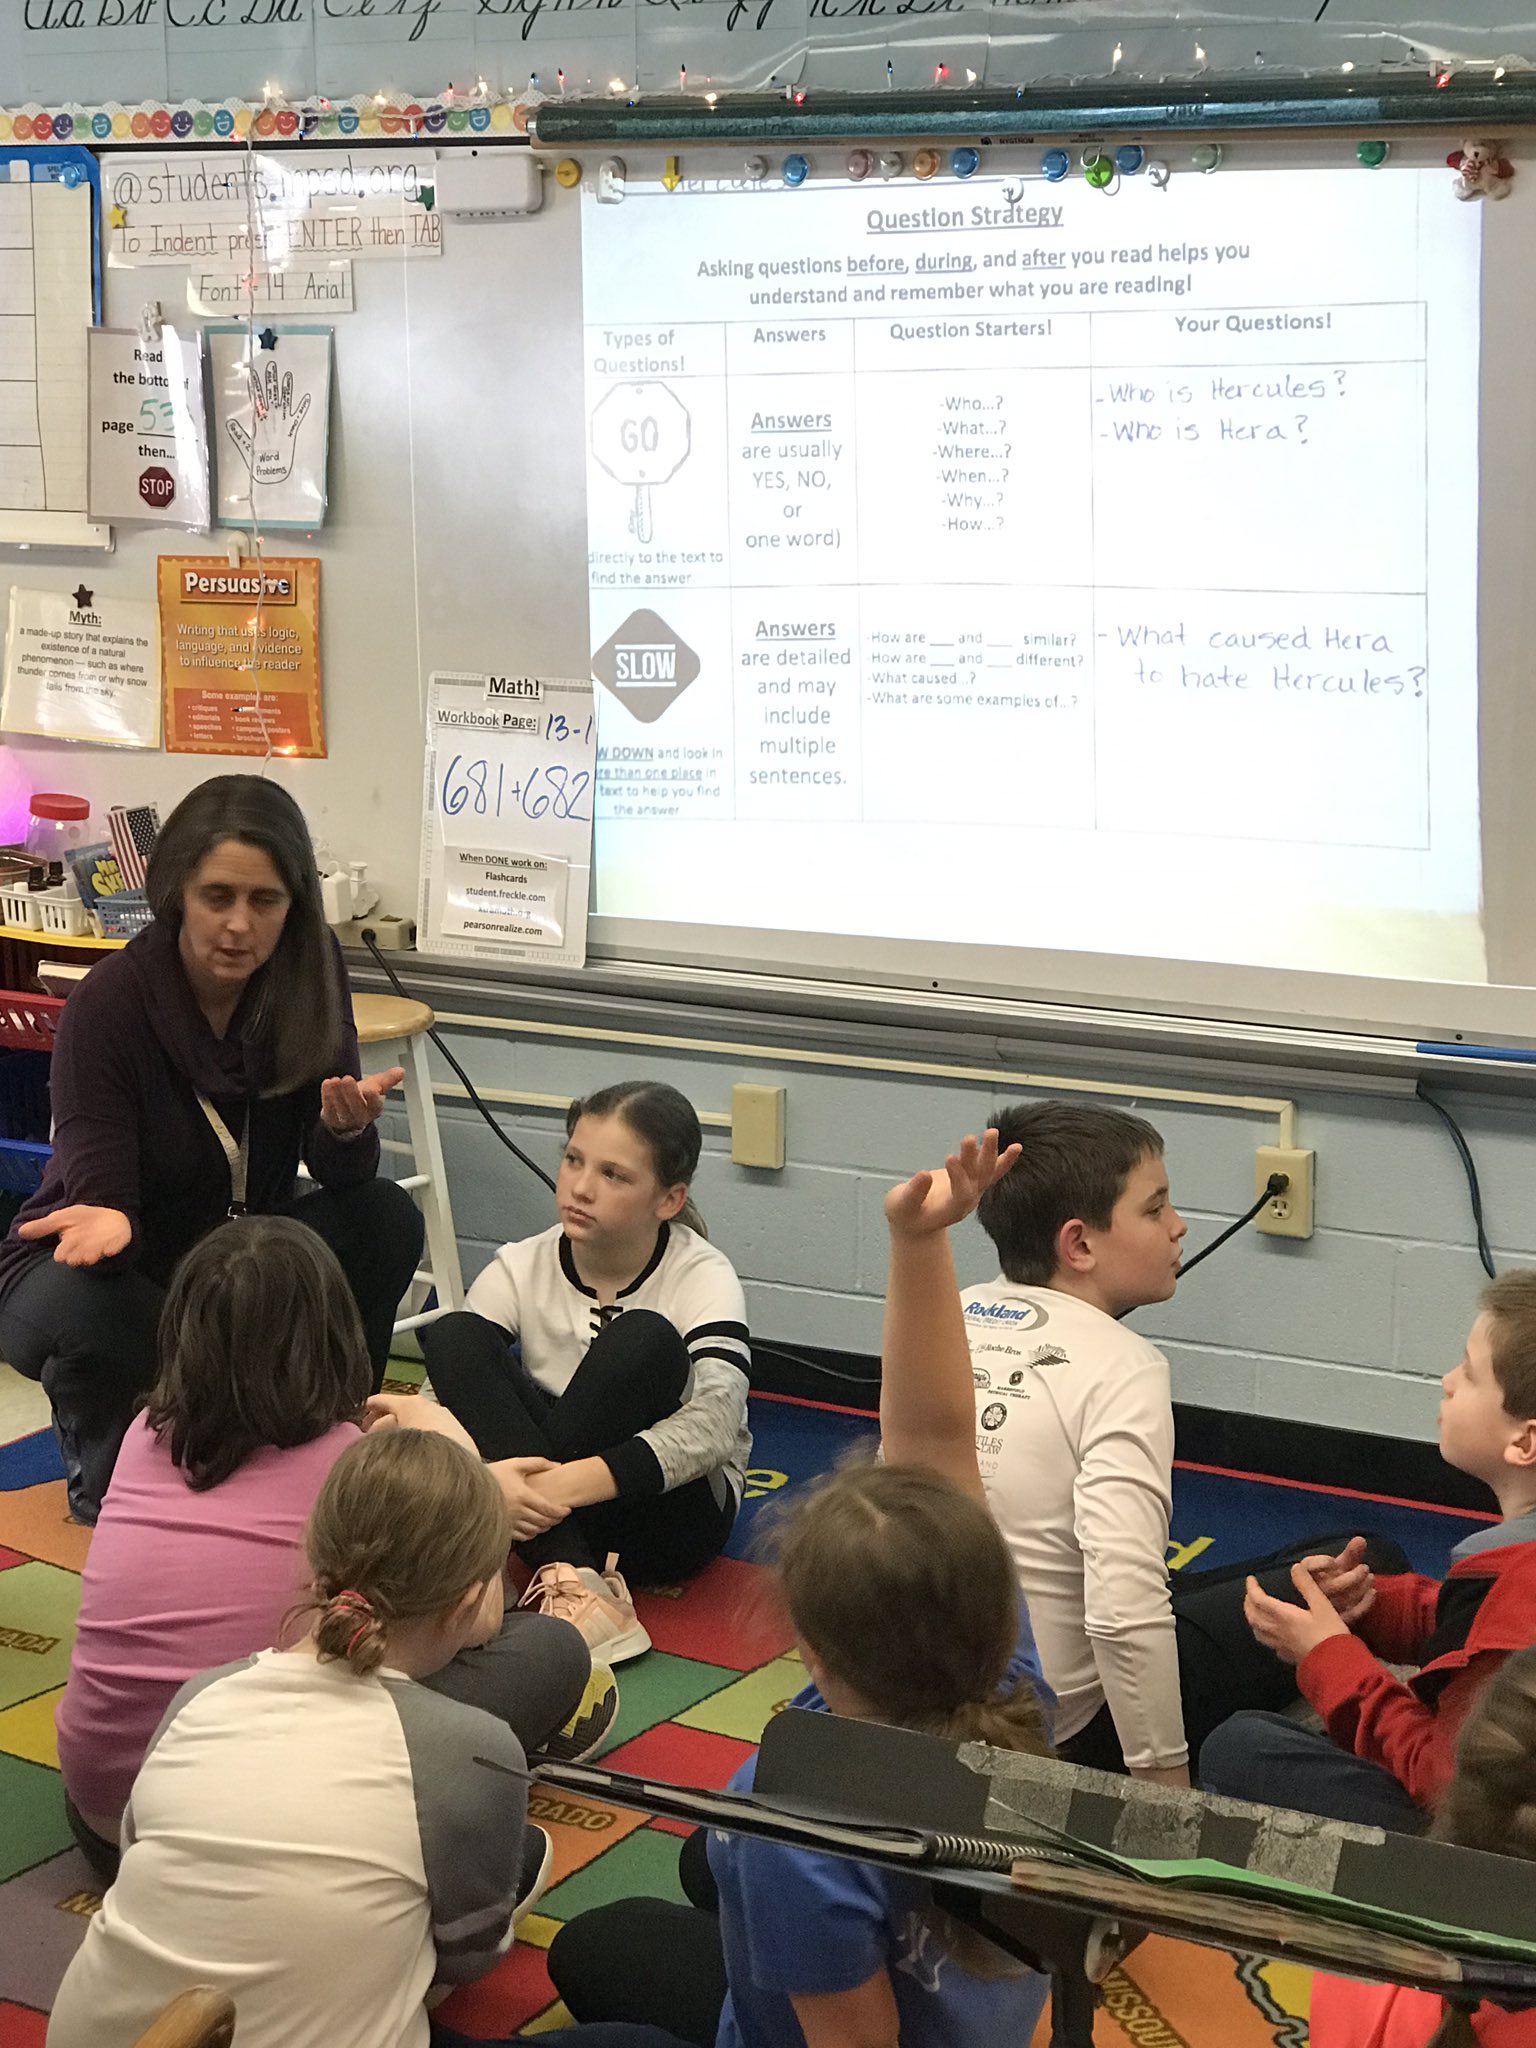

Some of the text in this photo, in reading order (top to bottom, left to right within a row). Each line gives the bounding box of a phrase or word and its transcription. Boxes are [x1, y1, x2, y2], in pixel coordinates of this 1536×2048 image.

[867, 204, 1064, 234] Question Strategy
[112, 214, 441, 256] To Indent ENTER then TAB
[697, 243, 1250, 279] Asking questions before, during, and after you read helps you
[200, 272, 345, 301] Font 14 Arial
[750, 275, 1191, 305] understand and remember what you are reading!
[890, 319, 1052, 341] Question Starters!
[1175, 312, 1332, 333] Your Questions!
[603, 329, 674, 349] Types of
[753, 327, 826, 343] Answers
[134, 349, 163, 363] Read
[593, 356, 685, 377] Questions!
[113, 371, 135, 385] the
[1167, 381, 1193, 404] is
[102, 421, 134, 434] page
[751, 412, 832, 432] Answers
[1176, 418, 1200, 441] is
[620, 416, 659, 453] GO
[138, 445, 175, 459] then...
[742, 440, 842, 460] are usually
[141, 478, 173, 496] STOP
[752, 470, 831, 491] YES, NO,
[783, 505, 802, 518] or
[746, 528, 841, 549] one word)
[639, 552, 723, 564] to the text to
[592, 571, 691, 585] find the answer
[69, 611, 102, 626] Myth:
[27, 628, 148, 647] made-up story that explains the
[177, 624, 299, 642] Writing that logic,
[755, 620, 837, 641] Answers
[904, 633, 1077, 647] are and similar?
[1209, 627, 1312, 650] caused
[1325, 627, 1393, 653] Hera
[41, 642, 125, 657] existence of natural
[176, 640, 227, 655] language,
[230, 643, 249, 654] and
[741, 648, 851, 666] are detailed
[22, 653, 143, 673] phenomenon such as where
[180, 655, 189, 667] to
[263, 659, 300, 671] reader
[615, 651, 676, 680] SLOW
[905, 653, 1084, 667] are and different?
[49, 670, 75, 679] comes
[109, 675, 124, 686] why
[127, 678, 147, 687] snow
[757, 677, 837, 696] and may
[1135, 658, 1426, 698] to hate Hercules?
[202, 690, 223, 699] Some
[487, 677, 540, 699] Math!
[912, 694, 1040, 708] are some examples
[764, 706, 831, 725] include
[437, 710, 592, 744] Workbook Page: 13-1
[613, 747, 654, 761] DOWN
[658, 748, 680, 759] and
[683, 748, 708, 759] look
[760, 736, 836, 757] multiple
[671, 767, 702, 780] place
[749, 768, 847, 785] sentences.
[443, 755, 590, 822] 681+682
[643, 785, 720, 798] help find
[637, 805, 679, 815] answer
[459, 853, 547, 870] When DONE work on:
[486, 872, 527, 884] Flashcards
[466, 887, 545, 902] student.freckle.com
[464, 920, 542, 936] pearsonrealize.com
[964, 1301, 1031, 1320] Rockland
[976, 1435, 1003, 1447] TILES
[528, 1798, 612, 1829] RADO
[1103, 1970, 1184, 2048] ISSOU
